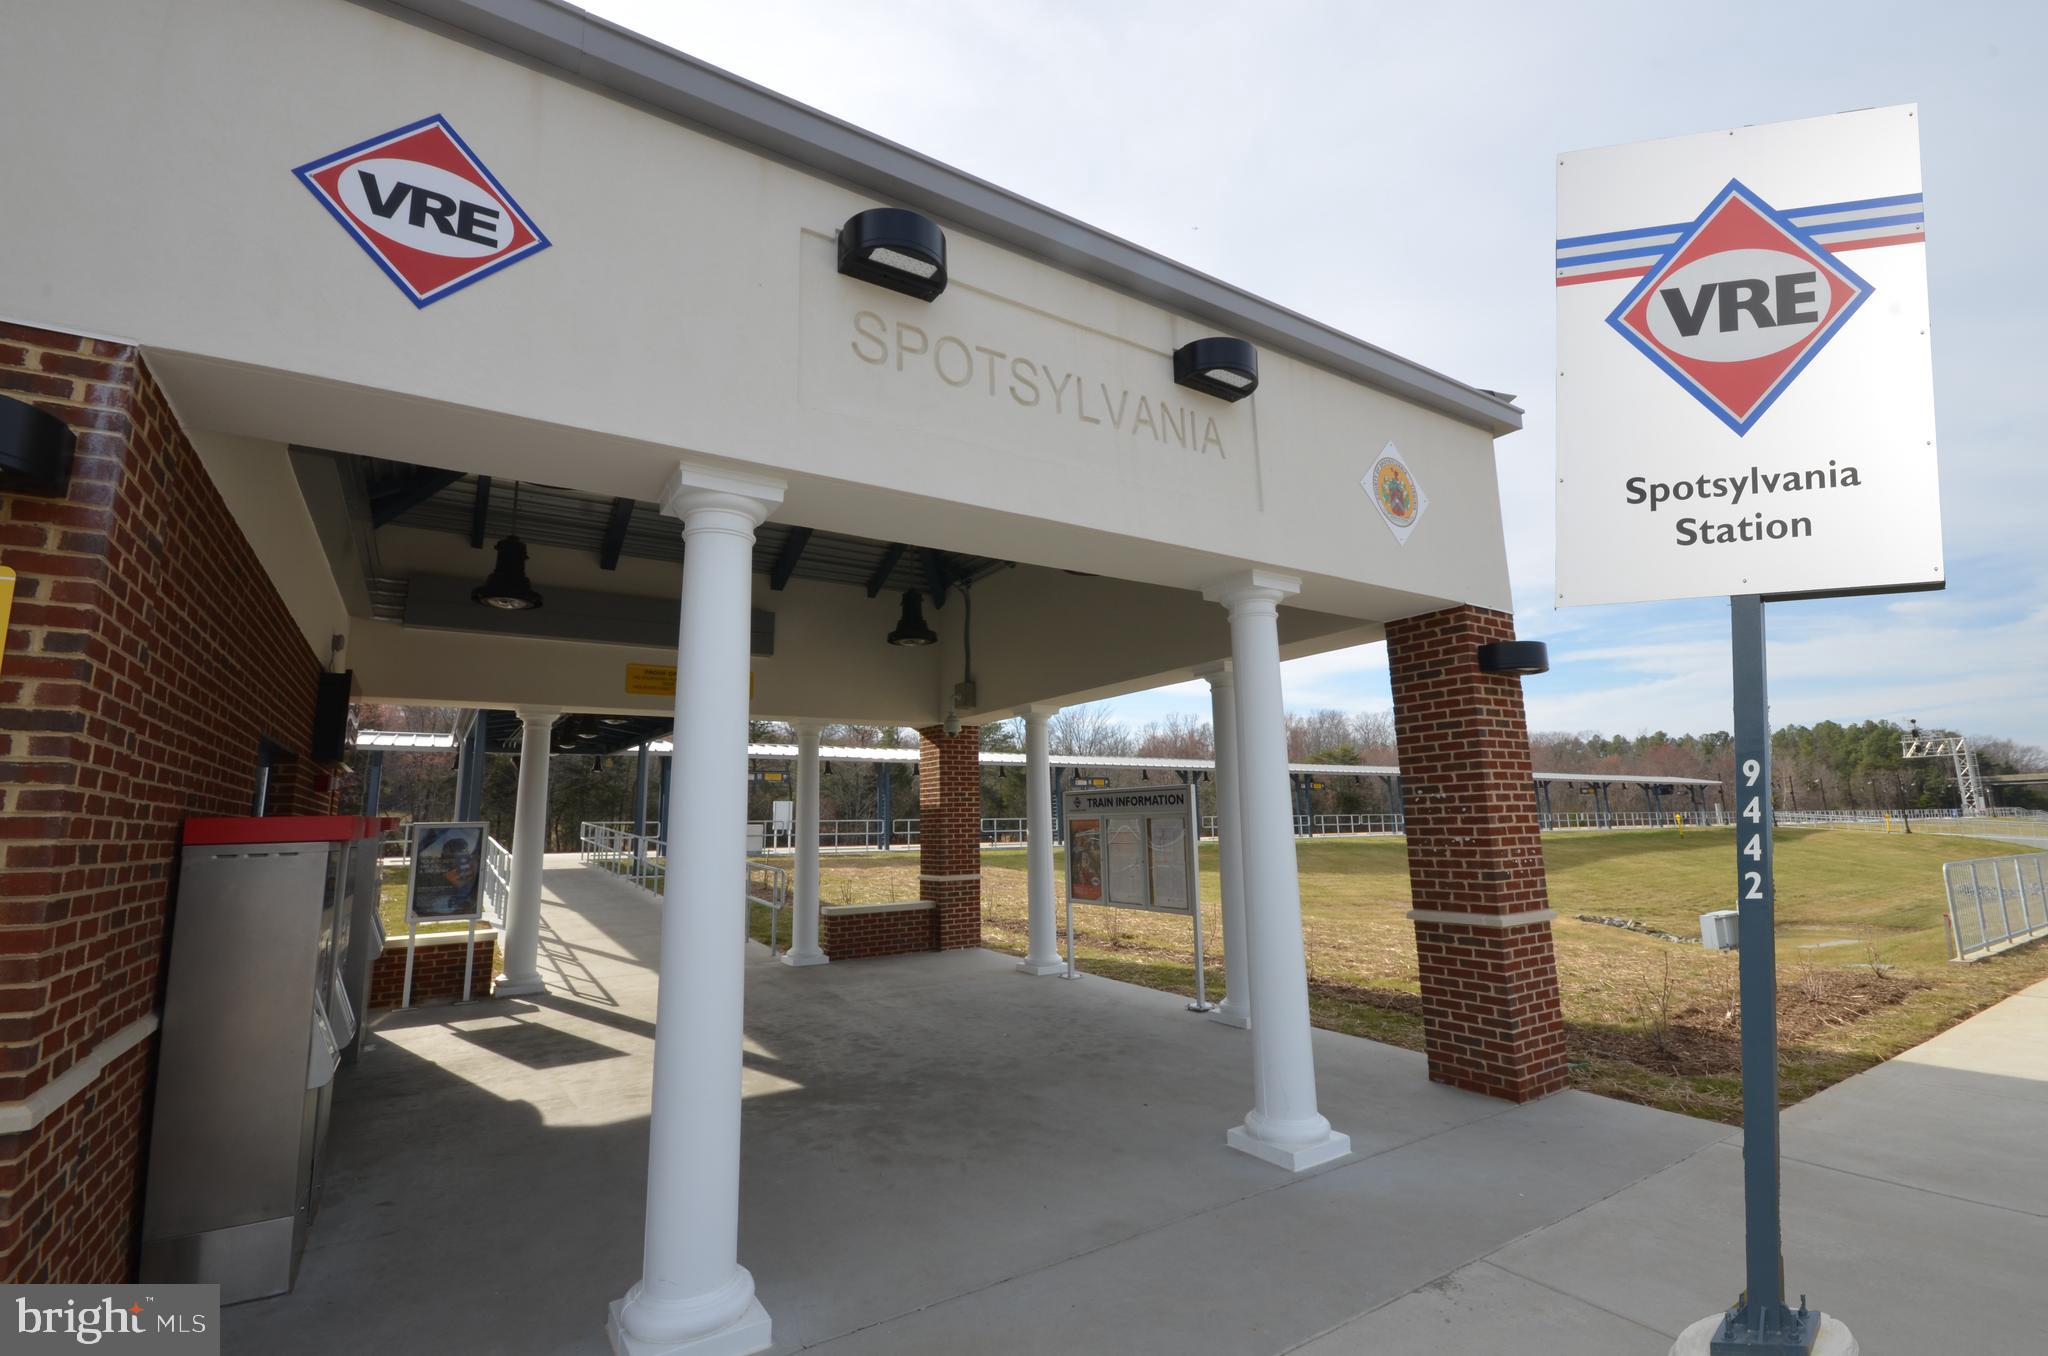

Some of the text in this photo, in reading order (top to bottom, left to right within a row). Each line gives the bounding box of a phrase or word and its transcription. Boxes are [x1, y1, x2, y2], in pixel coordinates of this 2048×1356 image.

[358, 169, 500, 249] VRE
[1659, 271, 1818, 337] VRE
[851, 309, 1227, 460] SPOTSYLVANIA
[1625, 460, 1862, 511] Spotsylvania
[1675, 512, 1812, 546] Station
[1087, 794, 1184, 808] TRAIN INFORMATION
